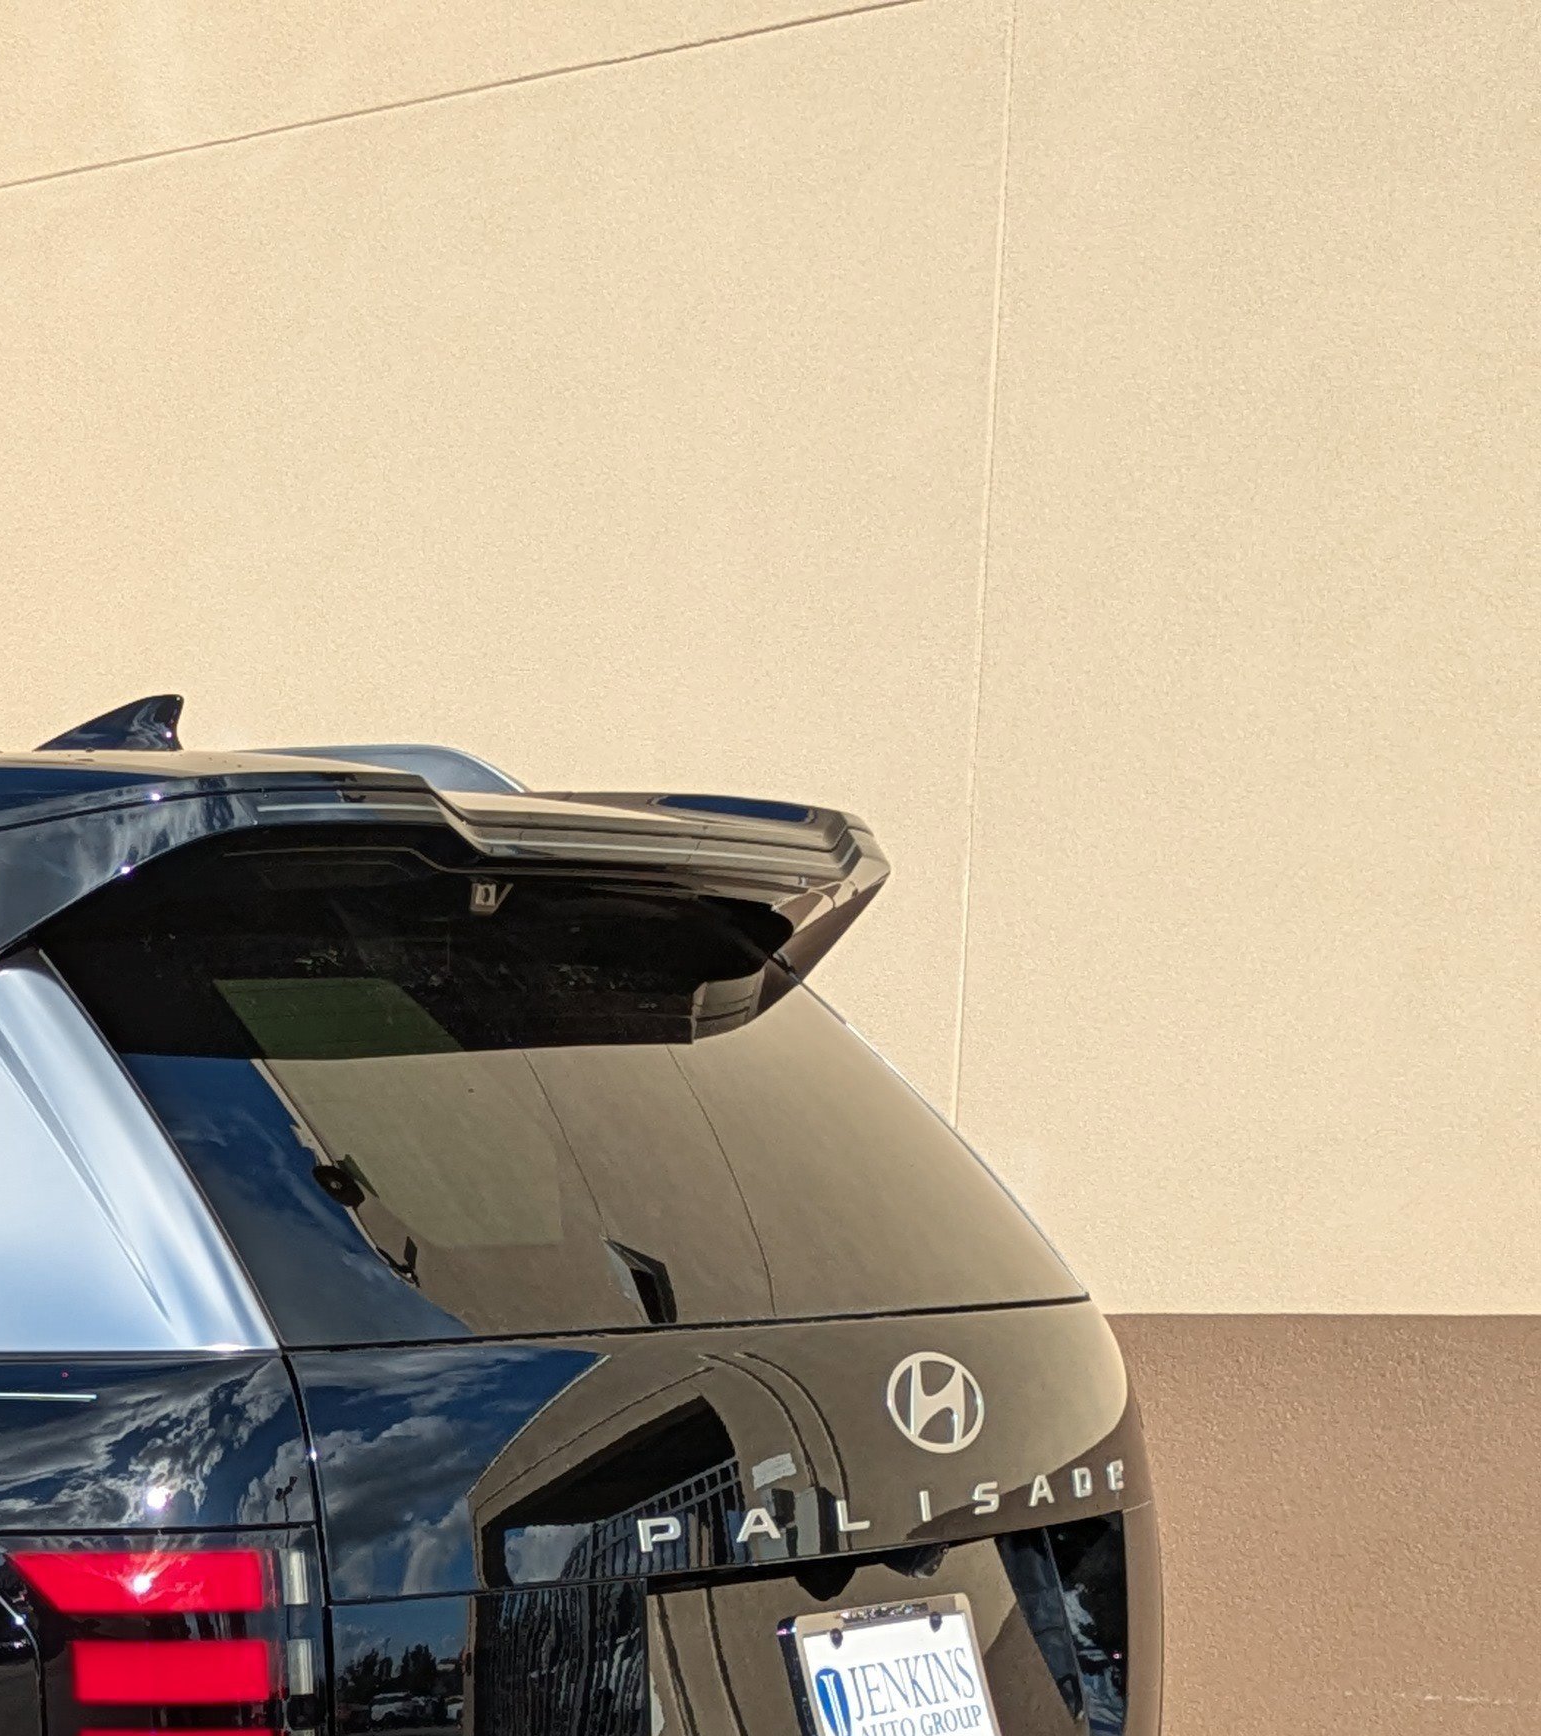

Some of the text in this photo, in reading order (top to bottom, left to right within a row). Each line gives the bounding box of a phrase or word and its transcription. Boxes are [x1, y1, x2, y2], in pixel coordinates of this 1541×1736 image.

[637, 1459, 1123, 1553] PALISADE
[848, 1648, 975, 1722] JENKINS
[920, 1705, 982, 1736] GROUP
